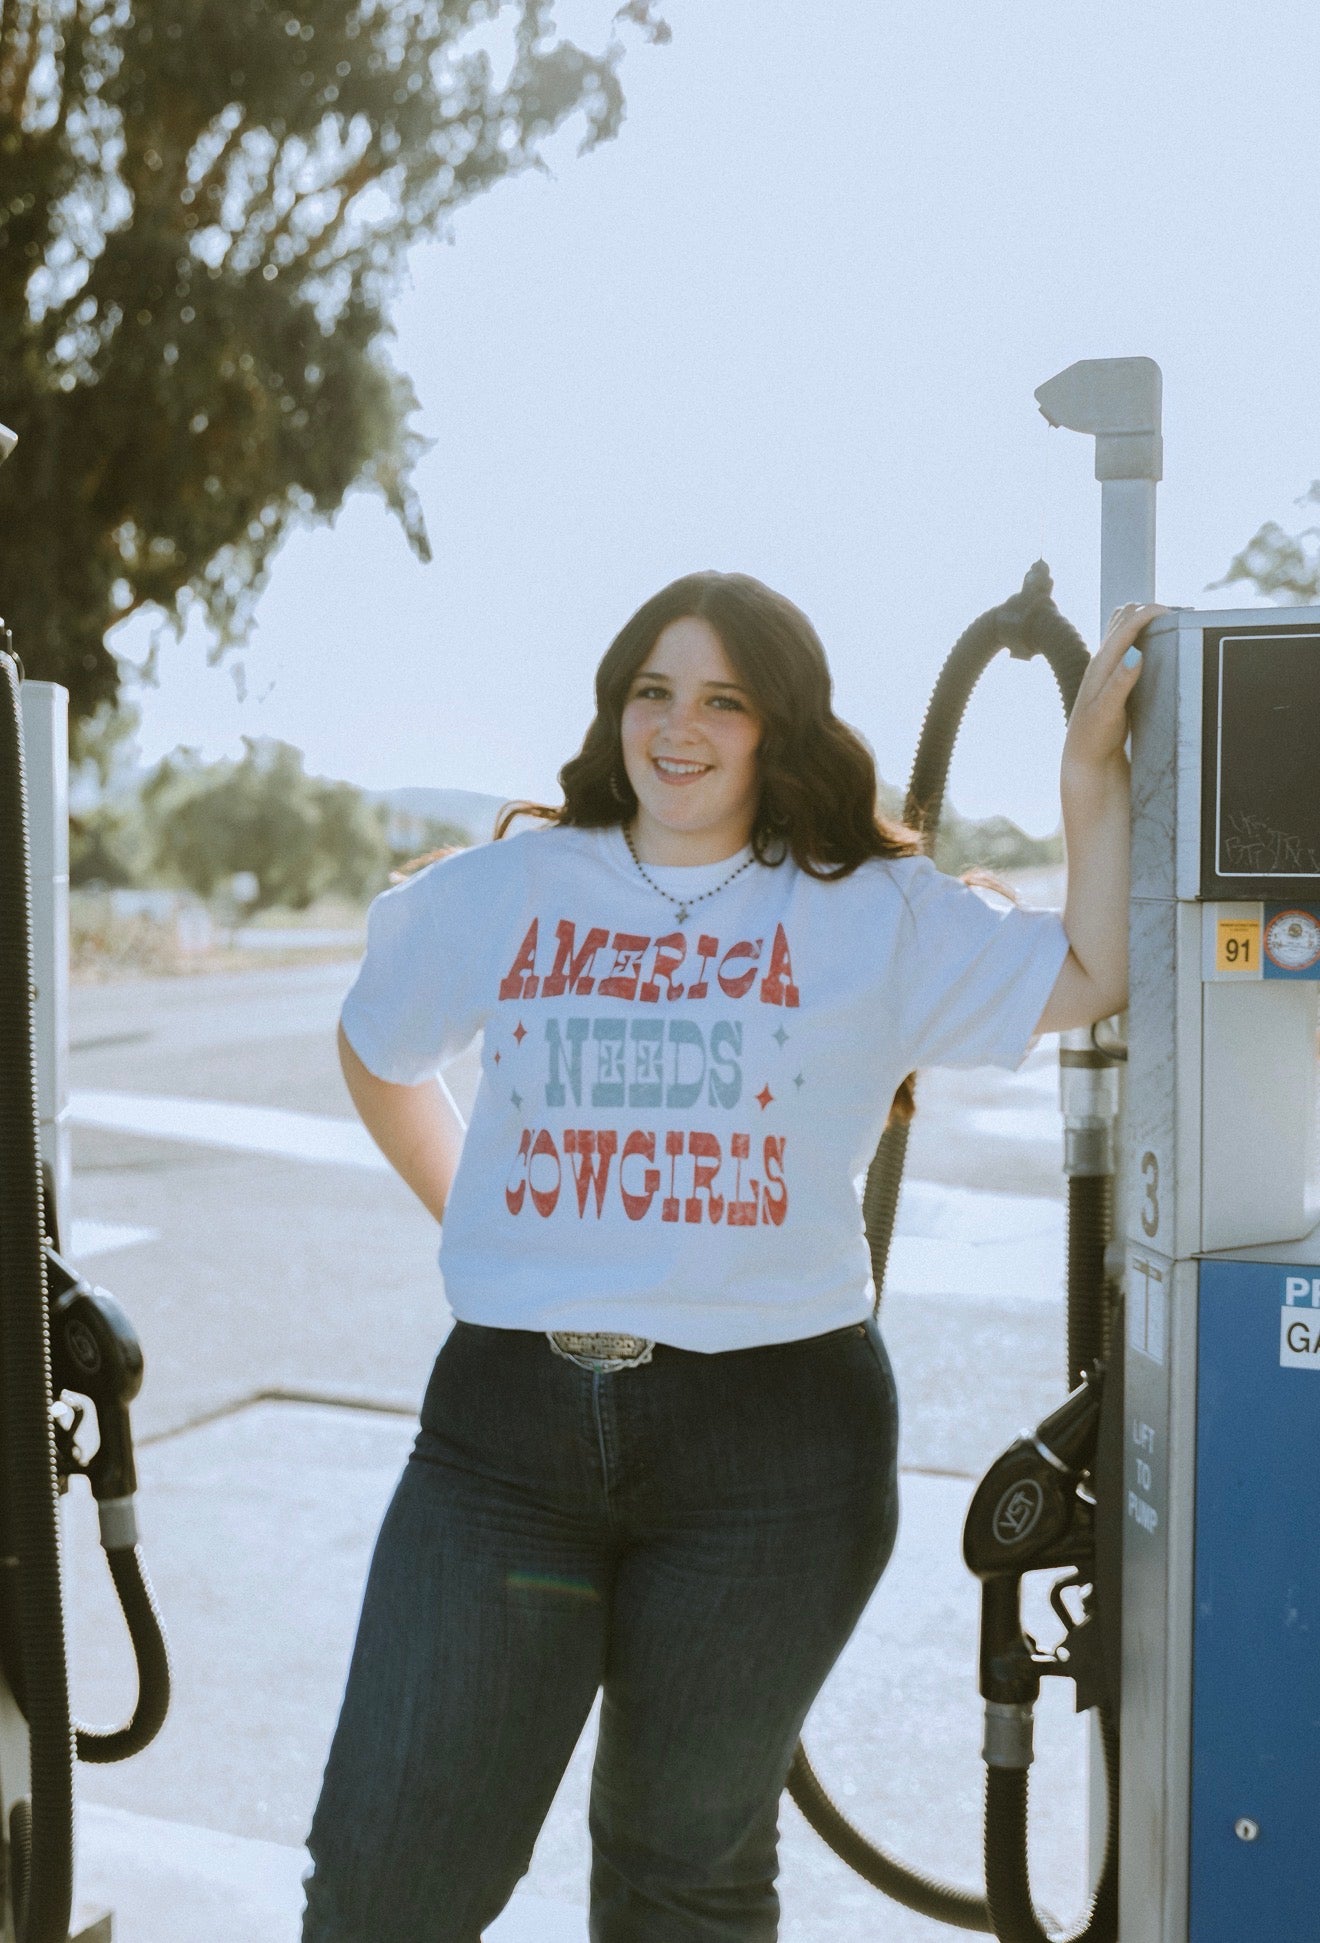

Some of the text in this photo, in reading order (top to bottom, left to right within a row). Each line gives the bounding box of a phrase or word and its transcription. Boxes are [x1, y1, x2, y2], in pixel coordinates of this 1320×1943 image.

[498, 916, 800, 1008] AMERICA
[1226, 938, 1250, 962] 91
[544, 1017, 743, 1111] NEEDS
[505, 1128, 789, 1227] COWGIRLS
[1141, 1150, 1160, 1238] 3
[1287, 1321, 1320, 1354] G
[1136, 1457, 1152, 1491] TO
[1127, 1488, 1159, 1535] PUMP
